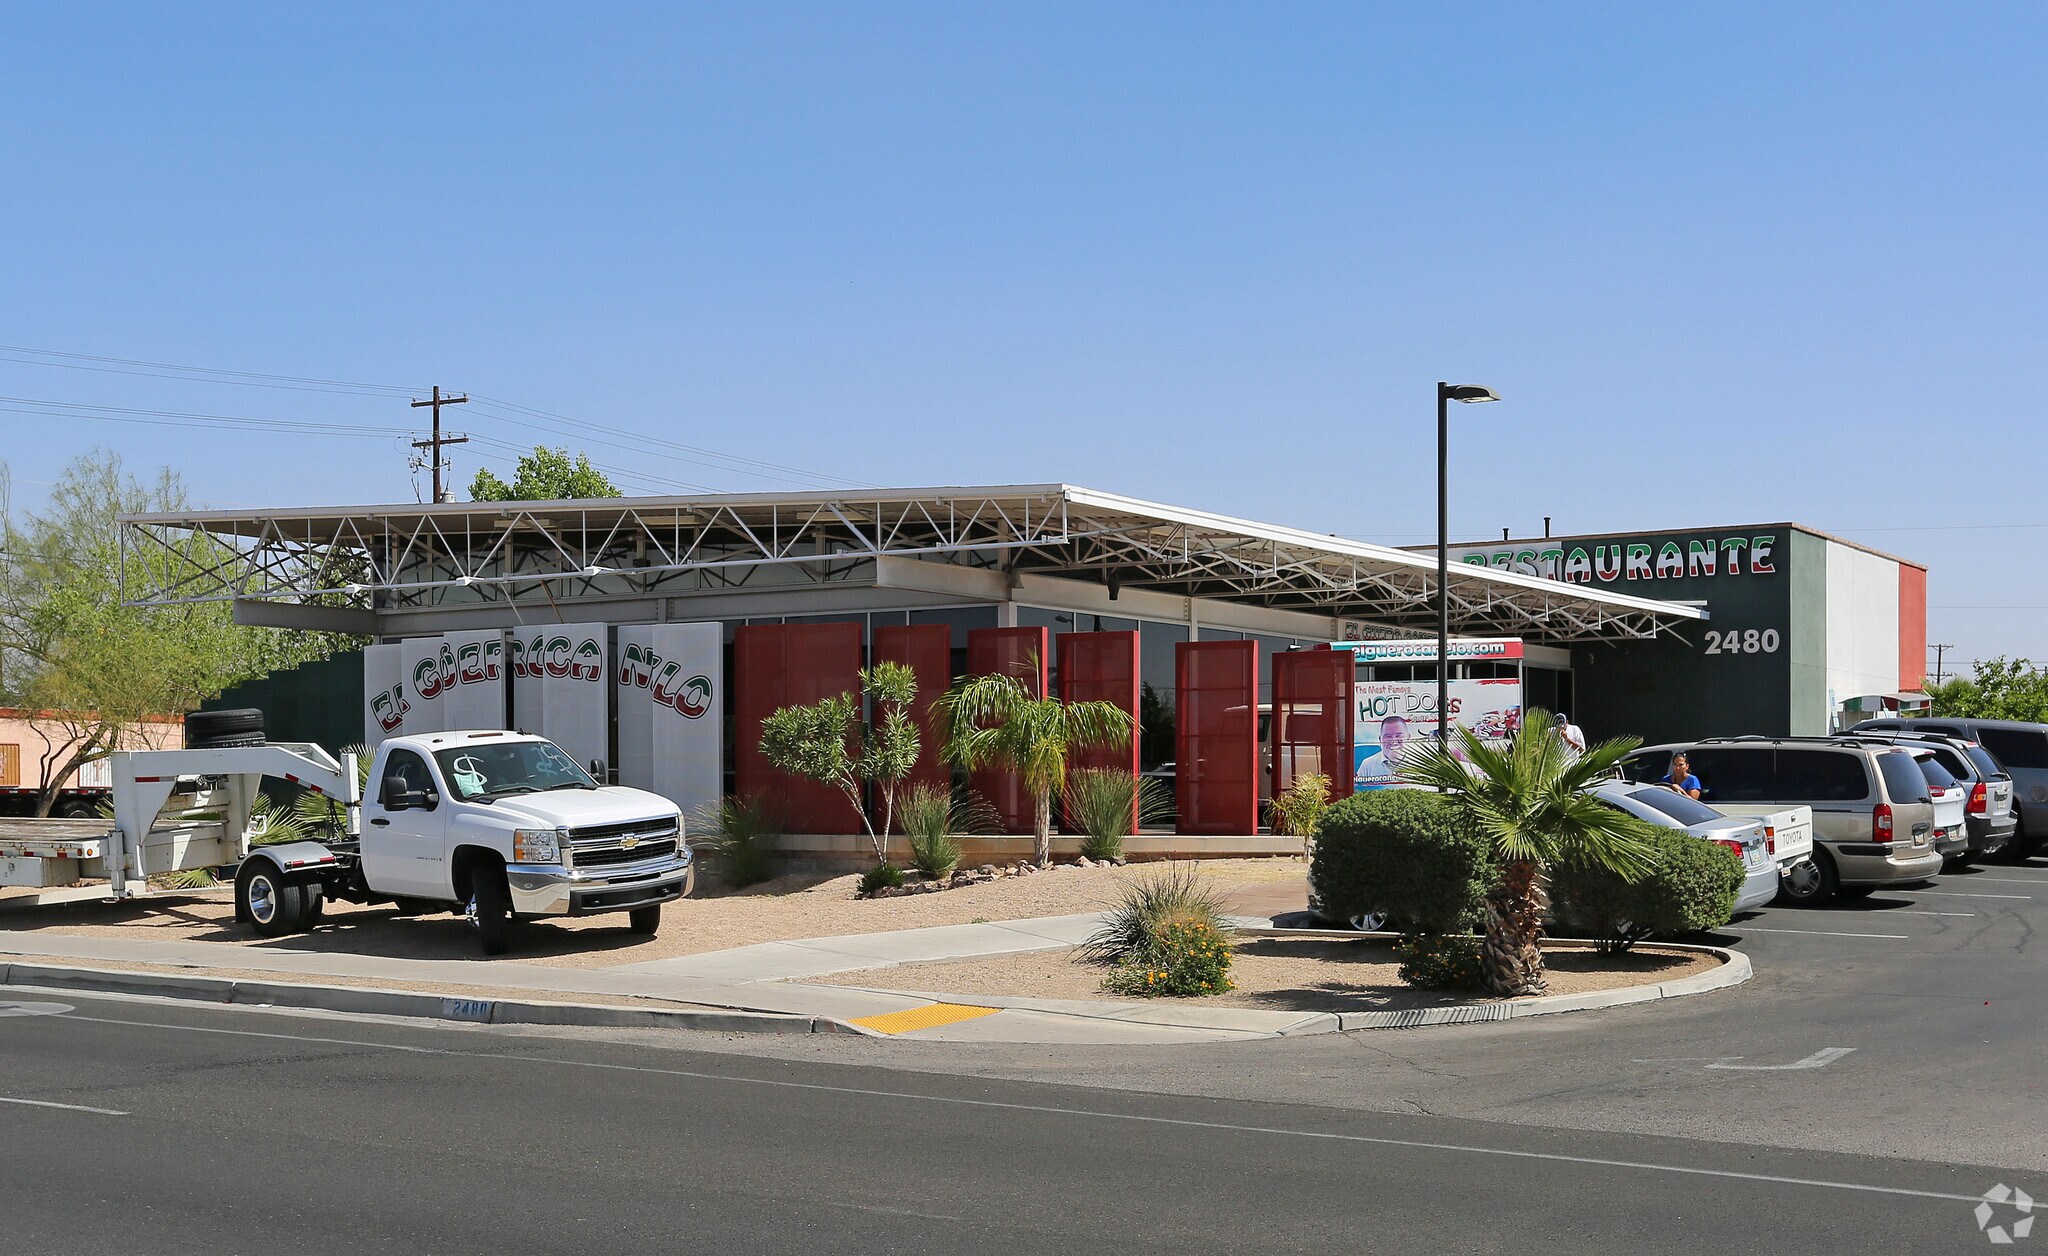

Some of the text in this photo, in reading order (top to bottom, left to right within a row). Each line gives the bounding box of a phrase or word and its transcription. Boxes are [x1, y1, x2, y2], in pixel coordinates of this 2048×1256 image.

[1704, 629, 1780, 655] 2480
[1355, 686, 1367, 695] The
[1368, 685, 1387, 694] Most
[1360, 694, 1401, 722] HOT
[1783, 830, 1803, 846] TOYOTA
[453, 1001, 488, 1016] 2480
